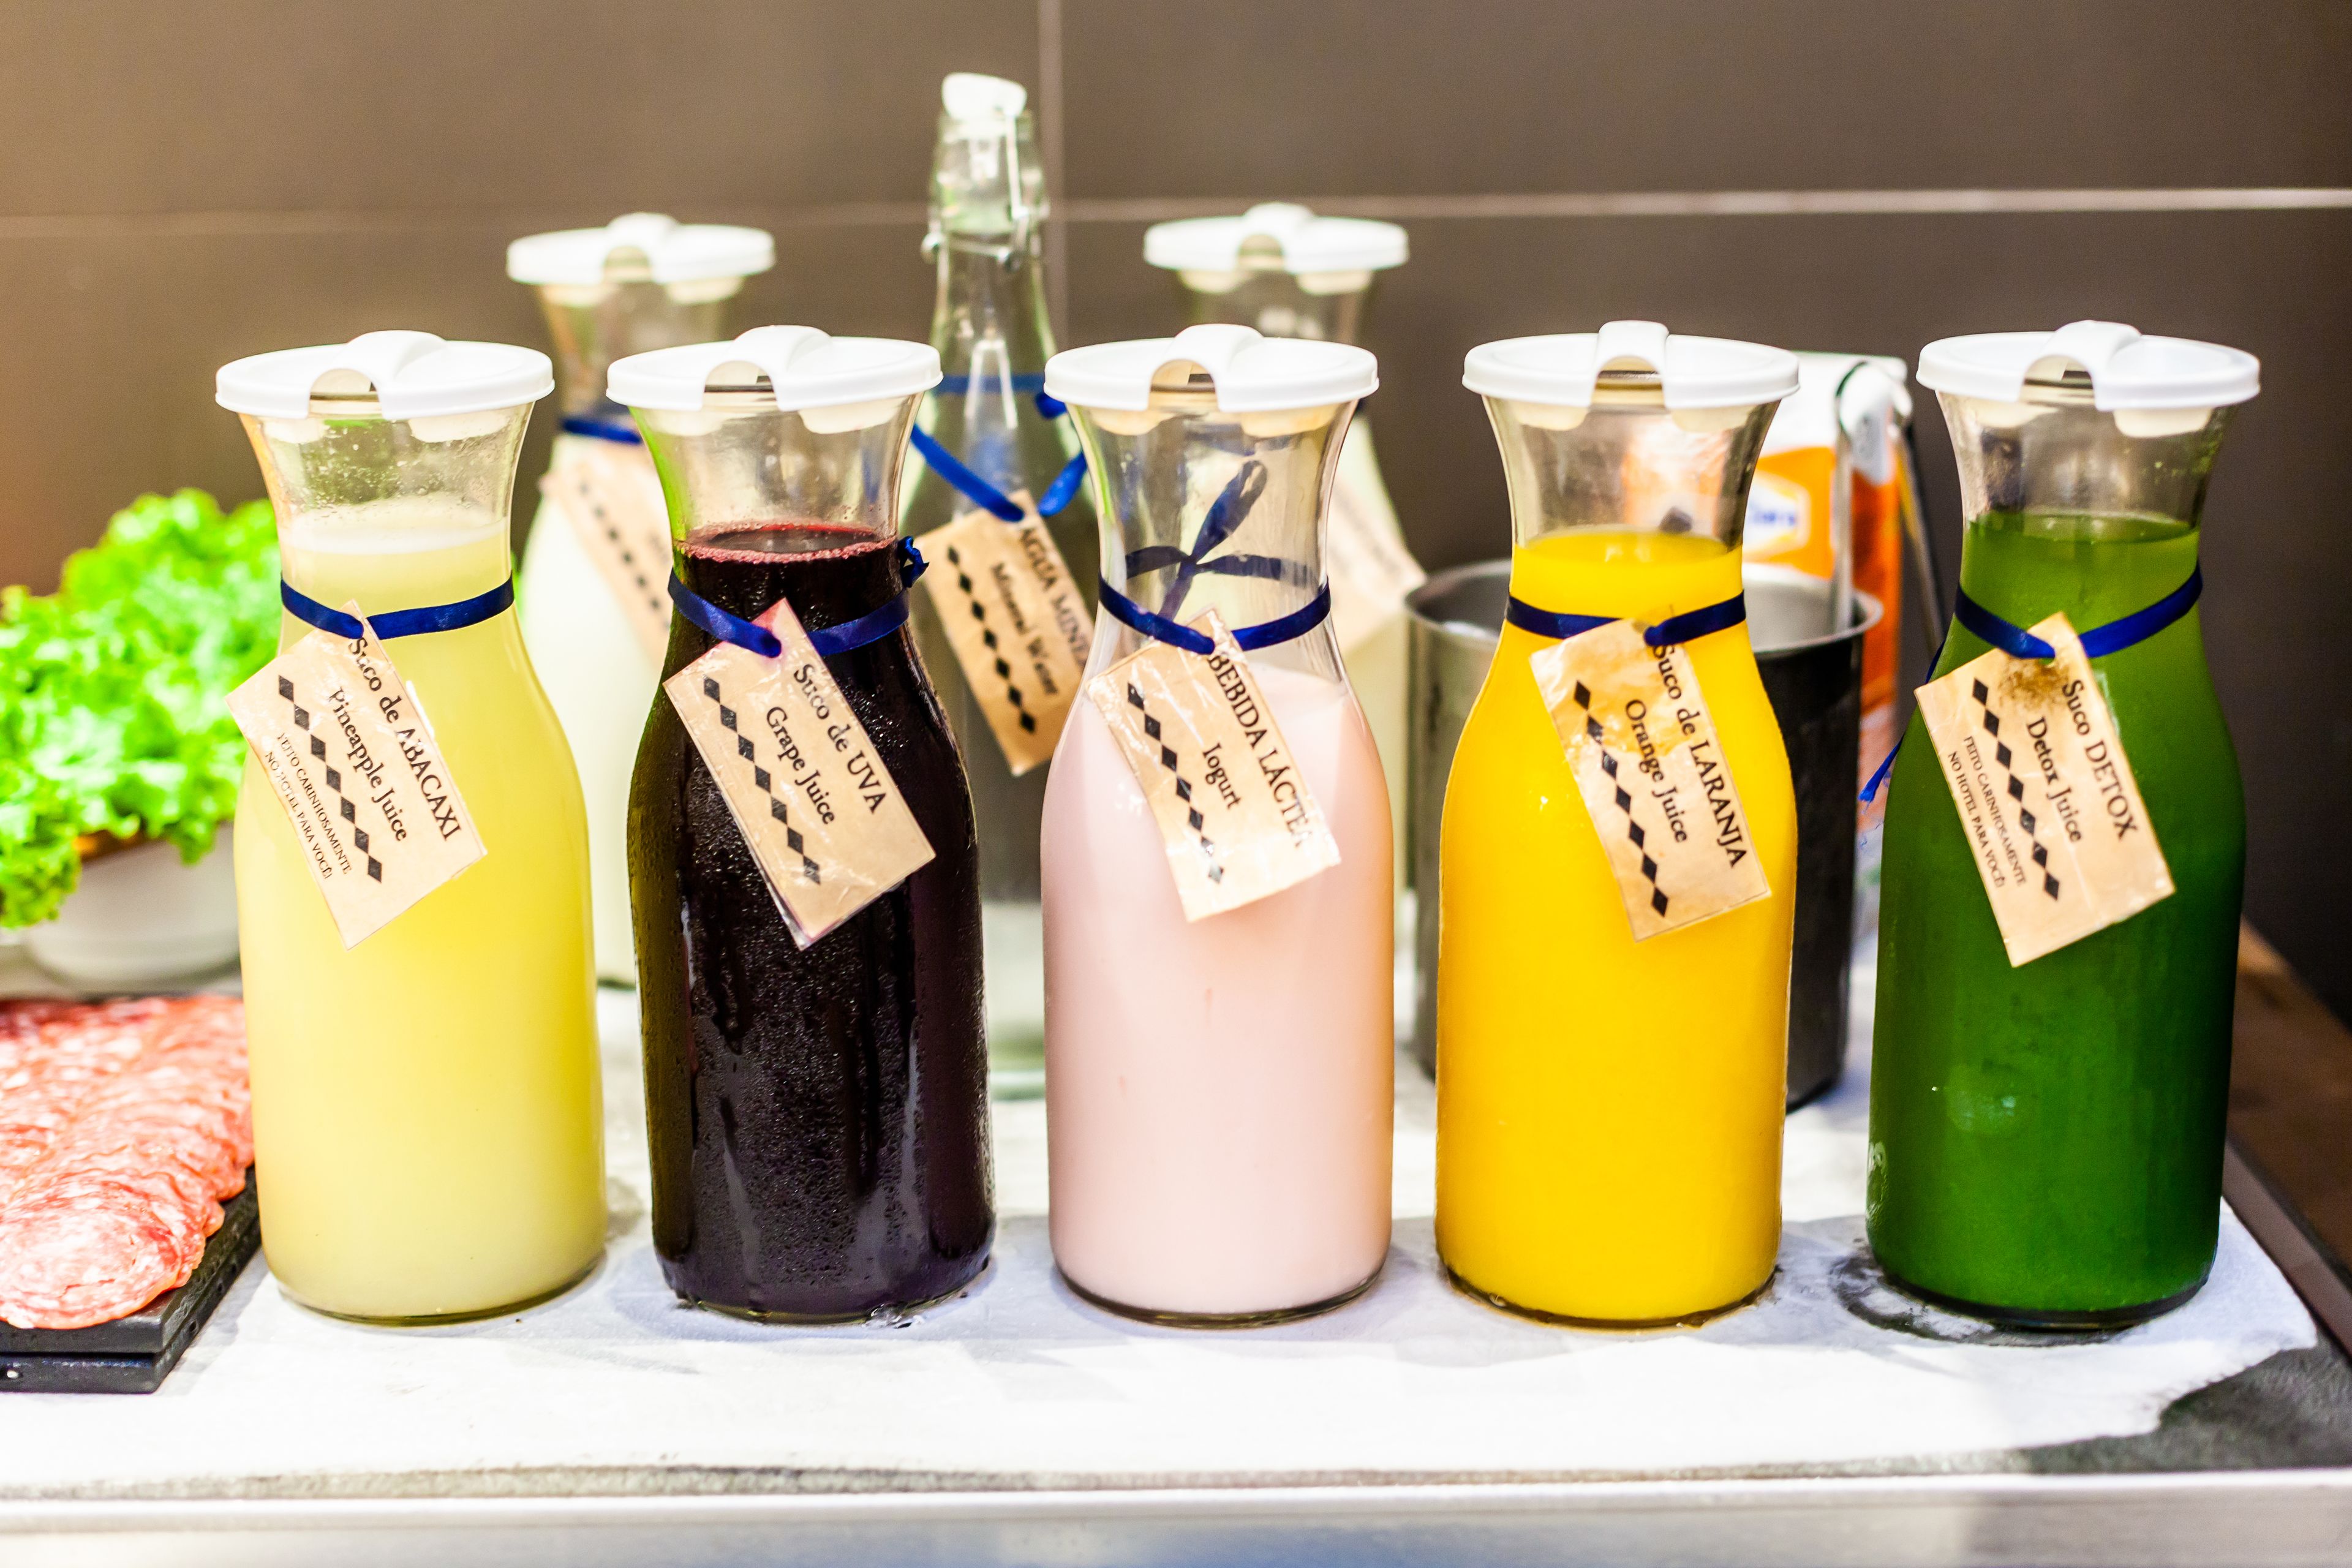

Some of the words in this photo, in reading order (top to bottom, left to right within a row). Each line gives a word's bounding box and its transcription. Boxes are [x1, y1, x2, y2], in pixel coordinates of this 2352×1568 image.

[328, 686, 384, 789] Pineapple
[371, 787, 407, 842] Juice
[348, 637, 382, 692] Suco
[379, 695, 402, 723] de
[395, 728, 462, 842] ABACAXI
[766, 706, 805, 772] Grape
[794, 769, 835, 825] Juice
[793, 663, 830, 720] Suco
[827, 723, 851, 753] de
[846, 750, 887, 814] UVA
[1207, 655, 1268, 750] BEBIDA
[1654, 644, 1682, 700] Suco
[1676, 707, 1701, 736] de
[1689, 739, 1747, 869] LARANJA
[2062, 679, 2090, 736] Suco
[2084, 739, 2138, 841] DETOX
[265, 752, 279, 771] NO
[296, 811, 315, 843] PARA
[296, 768, 353, 875] CARINHOSAMENTE
[1202, 742, 1242, 810] Iogurt
[1626, 699, 1664, 783] Orange
[1651, 785, 1687, 843] Juice
[1948, 751, 1961, 772] NO
[1956, 773, 1977, 815] HOTEL
[1972, 815, 1989, 850] PARA
[1964, 736, 1983, 771] FEITO
[1977, 772, 2027, 887] CARINHOSAMENTE
[2026, 716, 2059, 785] Detox
[2046, 786, 2082, 843] Juice
